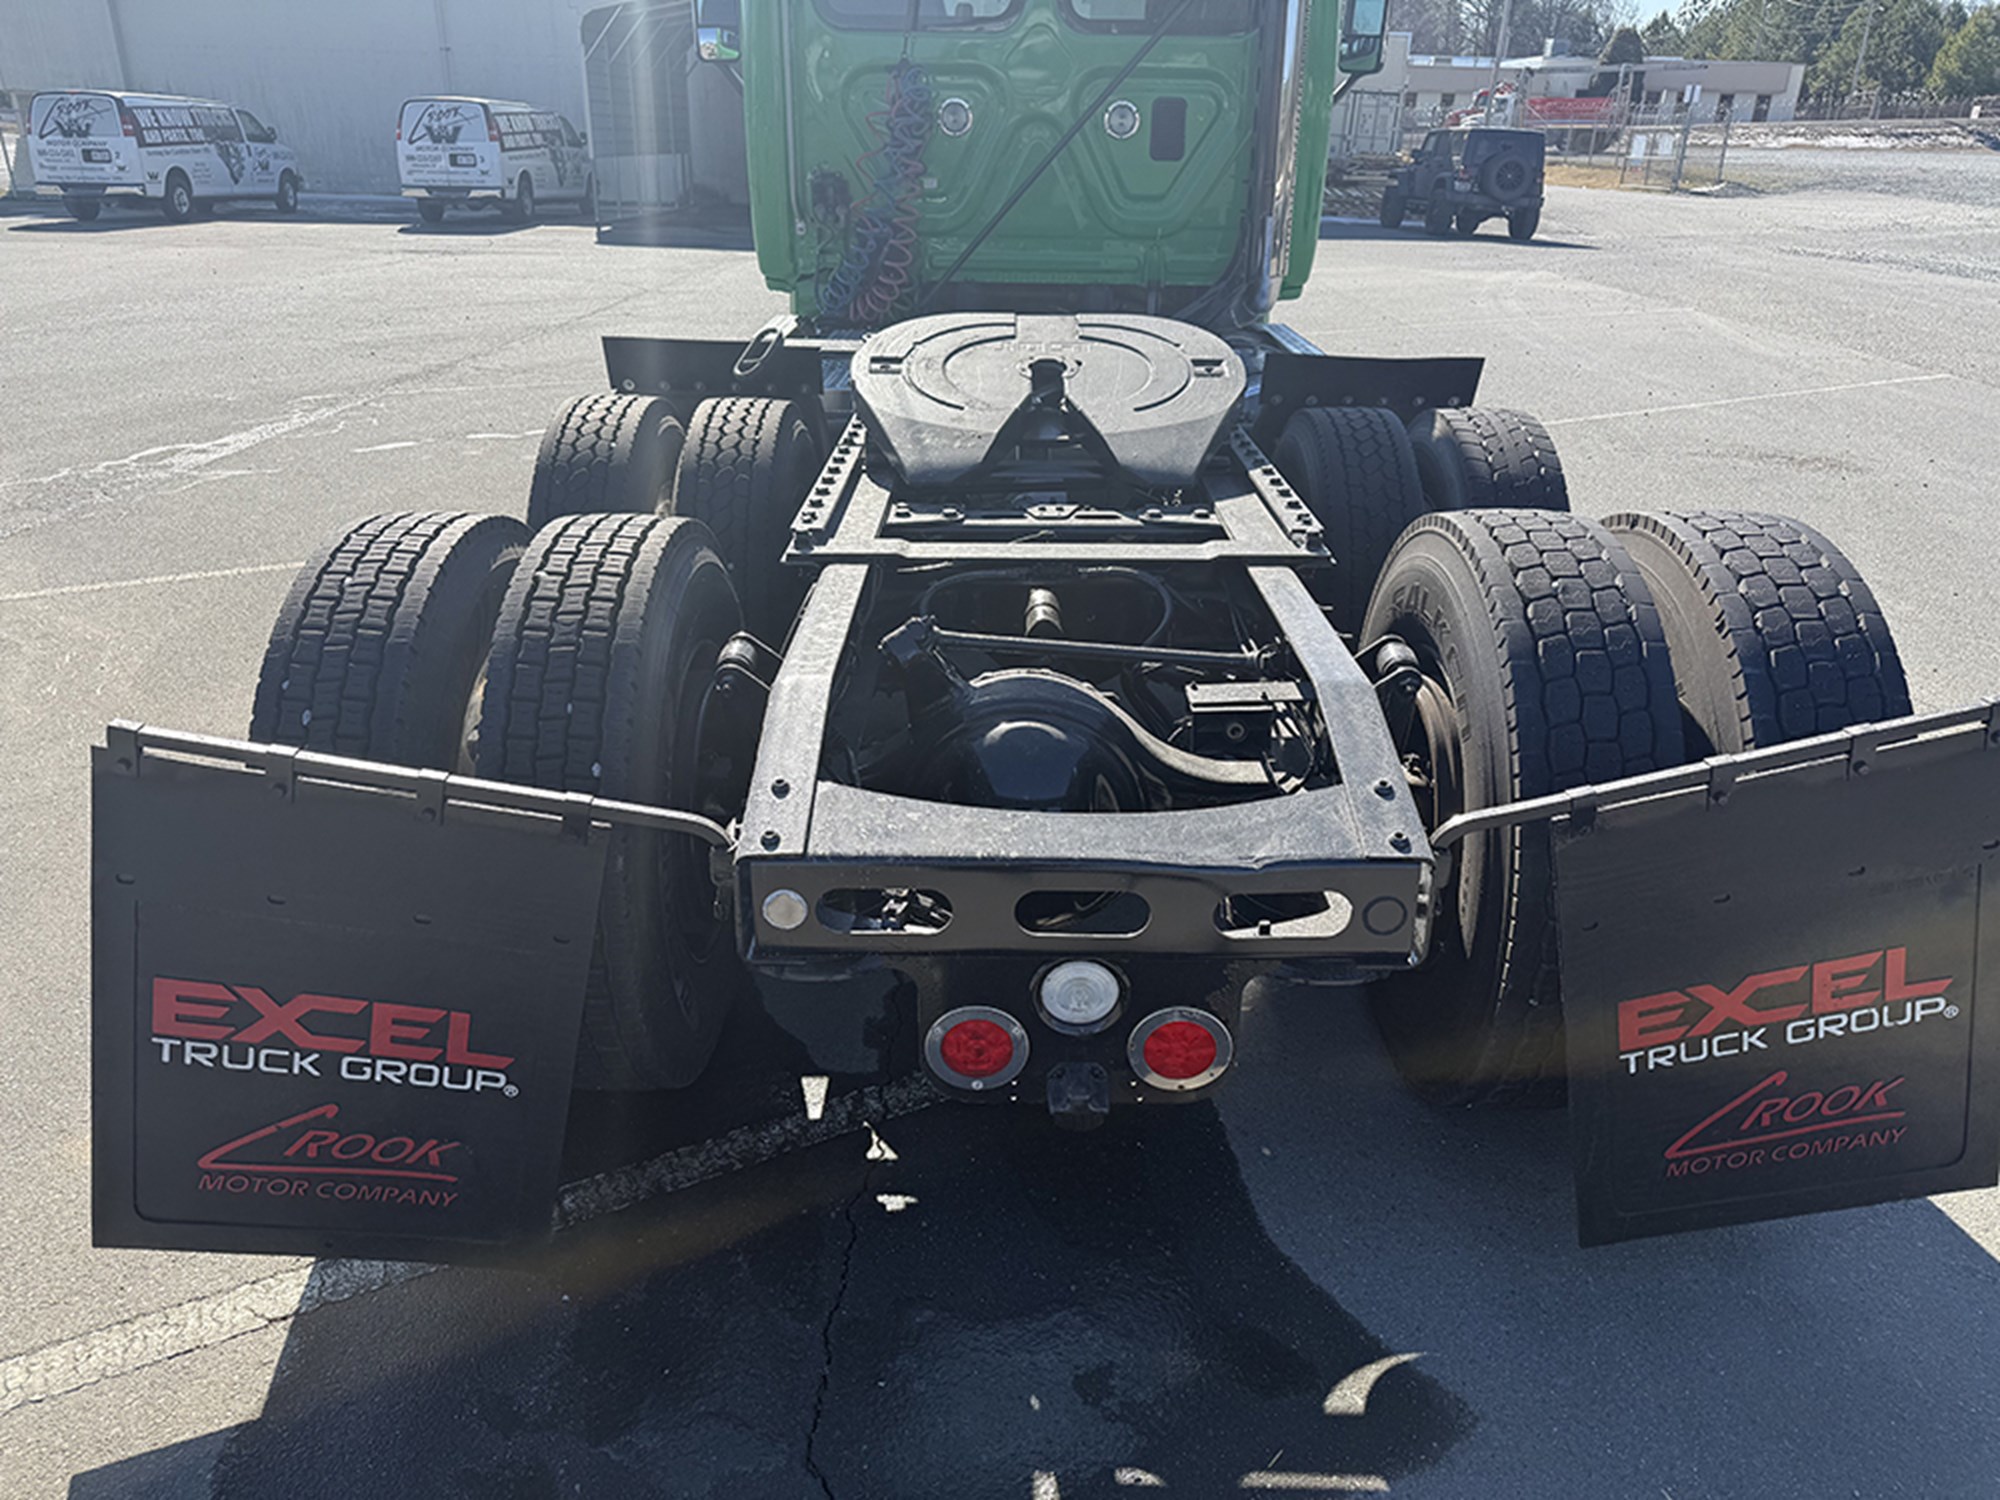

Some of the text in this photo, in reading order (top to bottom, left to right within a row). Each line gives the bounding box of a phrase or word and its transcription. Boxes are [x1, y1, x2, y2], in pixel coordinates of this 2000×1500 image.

[132, 108, 158, 127] WE
[153, 108, 194, 126] KNOW
[1617, 946, 1953, 1051] EXCEL
[152, 977, 515, 1070] EXCEL
[152, 1037, 321, 1077] TRUCK
[1619, 1026, 1769, 1075] TRUCK
[1666, 1126, 1908, 1177] MOTOR COMPANY
[198, 1174, 459, 1208] MOTOR COMPANY
